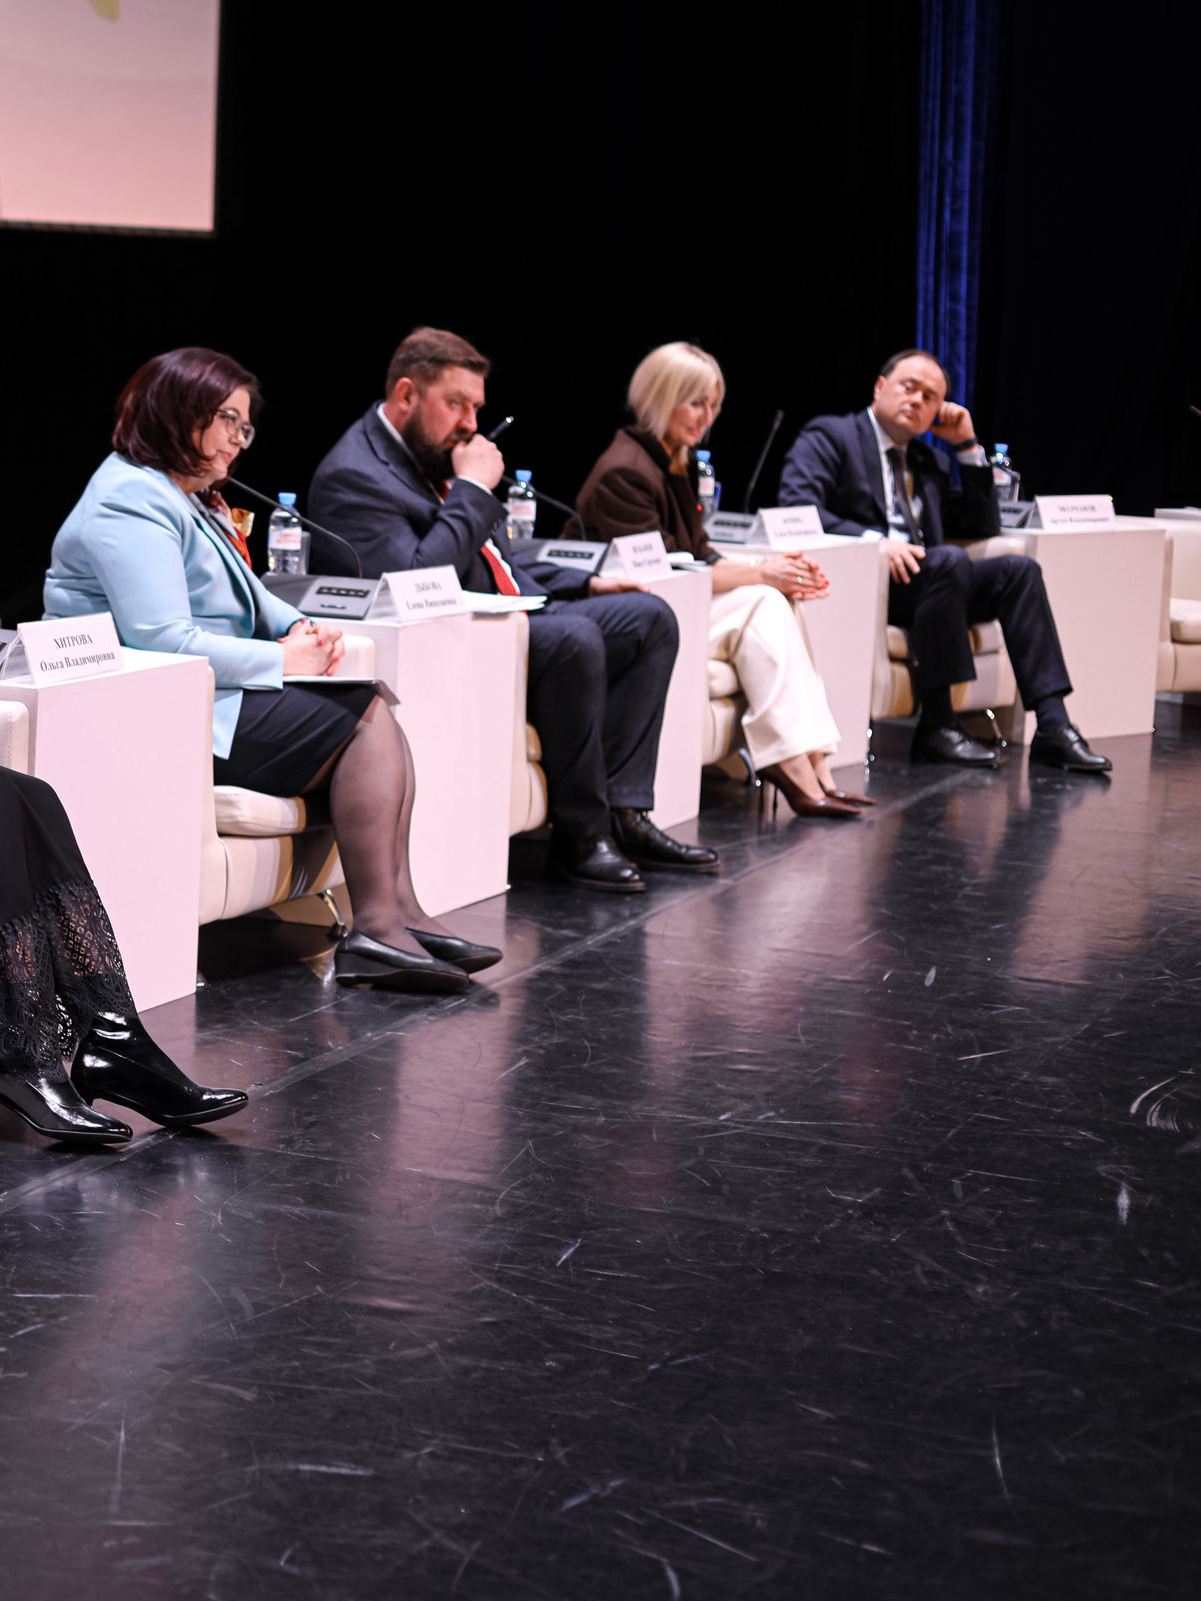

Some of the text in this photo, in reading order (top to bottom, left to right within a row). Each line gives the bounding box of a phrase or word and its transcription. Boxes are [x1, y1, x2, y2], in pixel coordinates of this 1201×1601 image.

[53, 633, 93, 649] ХИТРОВА
[40, 652, 115, 673] Ольга Владимировна
